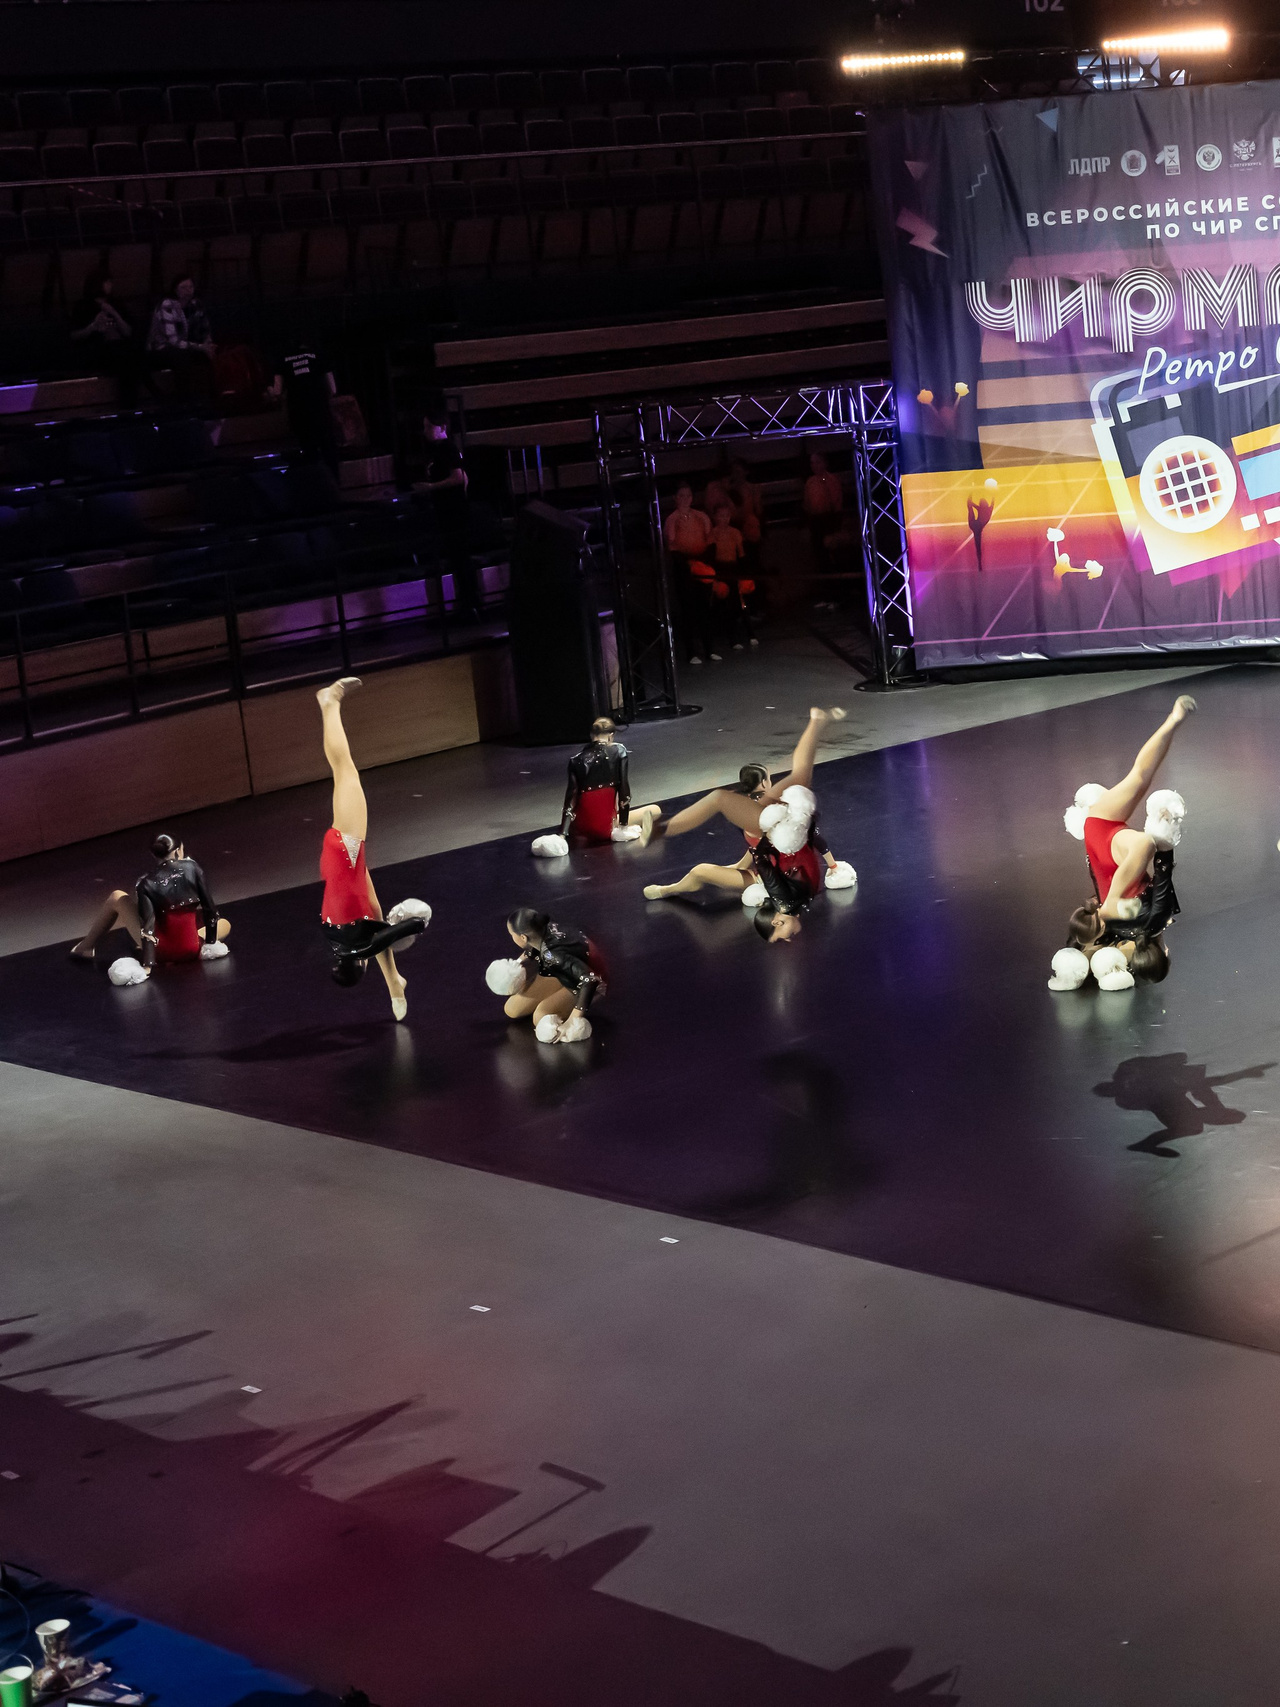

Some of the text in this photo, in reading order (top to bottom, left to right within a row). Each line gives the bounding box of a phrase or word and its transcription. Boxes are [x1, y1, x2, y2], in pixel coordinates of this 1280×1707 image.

[1068, 156, 1111, 177] ЛДПР
[1025, 194, 1250, 228] ВСЕРОССИЙСКИЕ
[1146, 223, 1180, 240] ПО
[1192, 217, 1245, 238] ЧИР
[1137, 345, 1259, 395] Ретро
